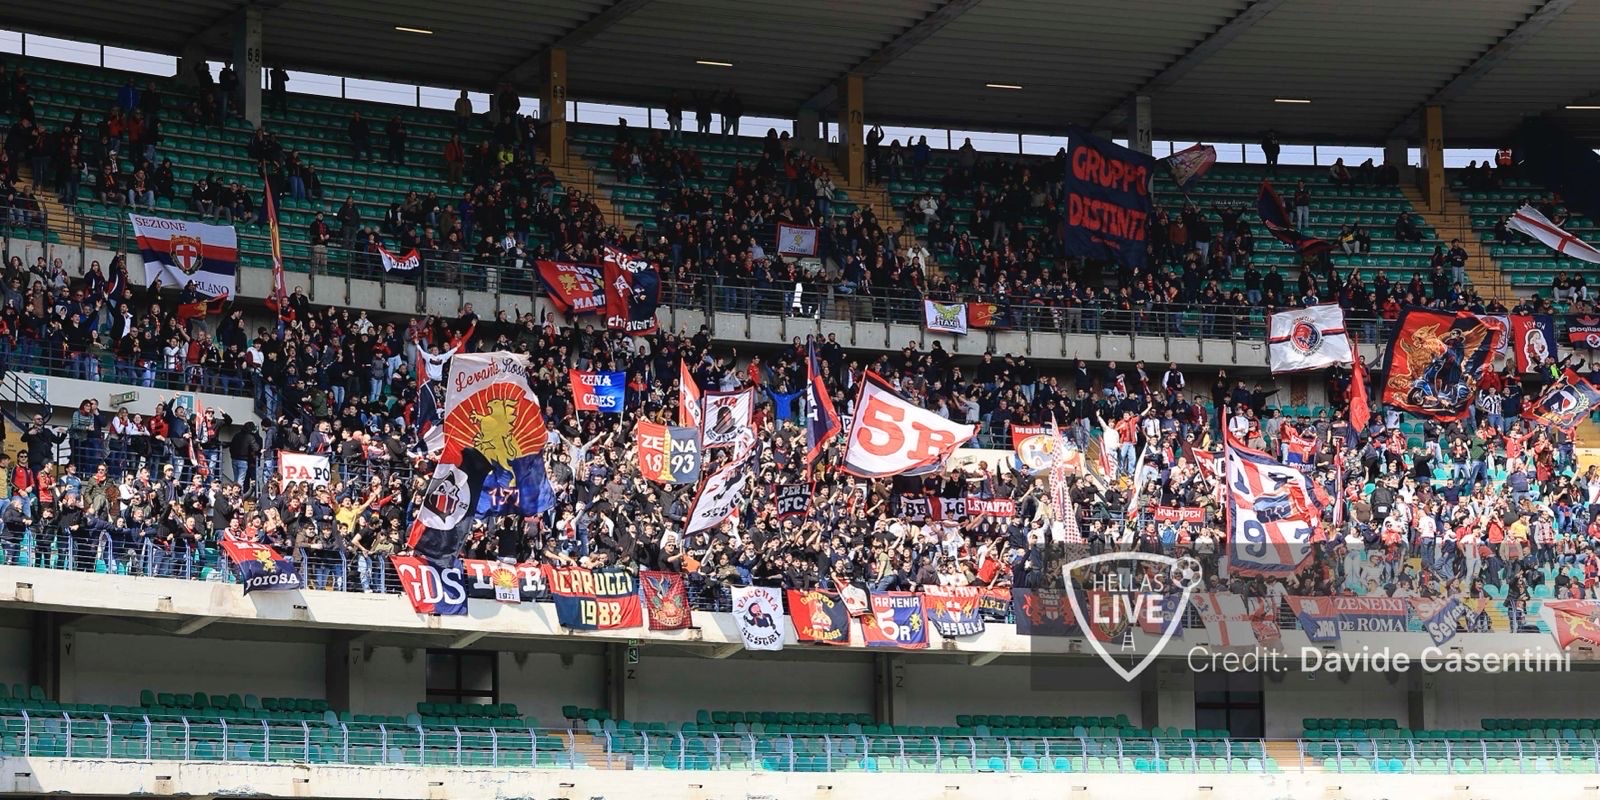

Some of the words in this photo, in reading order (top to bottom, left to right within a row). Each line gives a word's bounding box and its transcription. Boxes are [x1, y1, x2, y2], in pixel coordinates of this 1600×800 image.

[1072, 146, 1147, 196] GRUPPO
[134, 217, 187, 231] SEZIONE
[400, 563, 467, 605] GDS
[874, 597, 920, 608] ARMENIA
[580, 600, 622, 625] 1988
[1340, 621, 1355, 631] DE
[1357, 618, 1405, 632] ROMA
